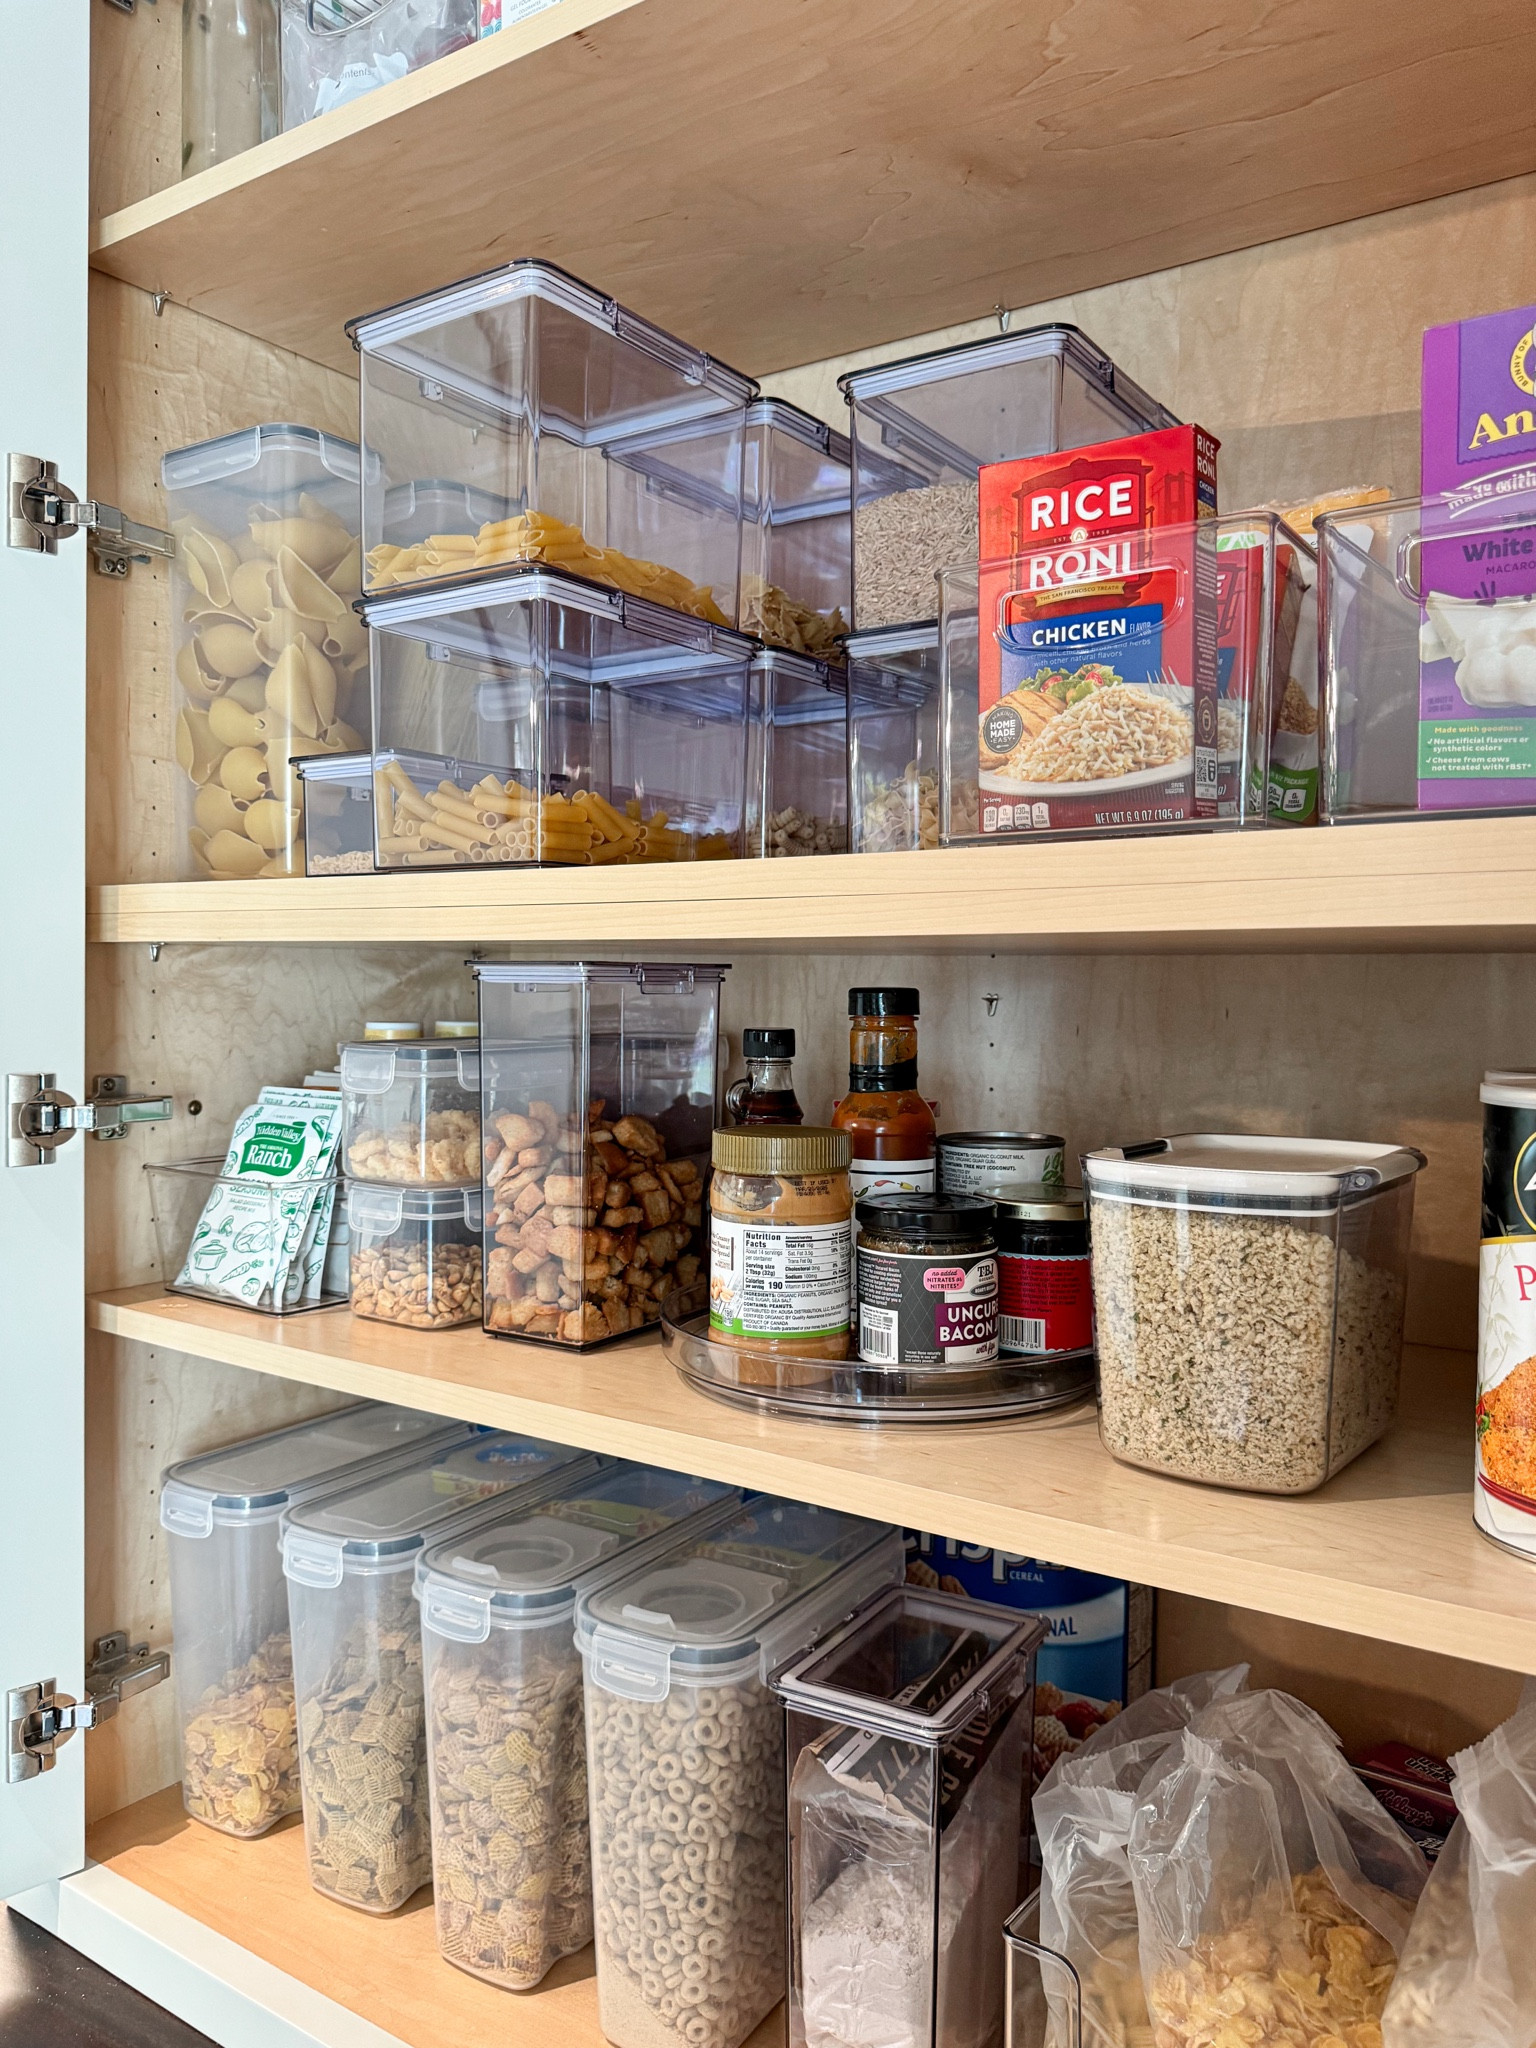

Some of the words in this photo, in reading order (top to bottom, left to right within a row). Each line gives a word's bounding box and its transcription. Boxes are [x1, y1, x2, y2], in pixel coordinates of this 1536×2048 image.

[1518, 339, 1528, 352] OF
[1514, 354, 1529, 387] BUNNY
[1197, 434, 1215, 460] RICE
[1031, 480, 1132, 531] RICE
[1075, 531, 1085, 541] A
[1462, 537, 1534, 563] White
[1030, 542, 1131, 589] RONI
[1064, 587, 1096, 596] FRANCISCO
[1032, 618, 1126, 646] CHICKEN
[1050, 657, 1068, 665] other
[1071, 652, 1096, 662] natural
[1098, 650, 1123, 659] flavors
[990, 720, 1016, 730] HOME
[1458, 725, 1479, 733] with
[1481, 725, 1523, 734] goodness
[990, 728, 1016, 739] MADE
[1446, 736, 1485, 745] artificial
[1486, 736, 1518, 744] flavors
[1433, 745, 1474, 754] synthetic
[1475, 744, 1503, 752] colors
[1432, 756, 1462, 764] Cheese
[1463, 756, 1485, 764] from
[1431, 764, 1449, 772] not
[1448, 763, 1481, 771] treated
[1482, 763, 1504, 771] with
[1095, 812, 1110, 825] NET
[1111, 811, 1125, 823] WT
[256, 1125, 281, 1136] Hidden
[281, 1127, 301, 1143] Valley
[245, 1144, 292, 1169] Ranch
[745, 1232, 781, 1241] Nutrition
[745, 1240, 767, 1248] Facts
[745, 1262, 764, 1270] Serving
[977, 1262, 995, 1278] TBJ
[940, 1269, 958, 1277] added
[745, 1277, 765, 1285] Calories
[926, 1276, 956, 1284] NITRATES
[768, 1281, 783, 1290] 190
[939, 1320, 993, 1342] BACON
[1010, 1570, 1044, 1583] CEREAL
